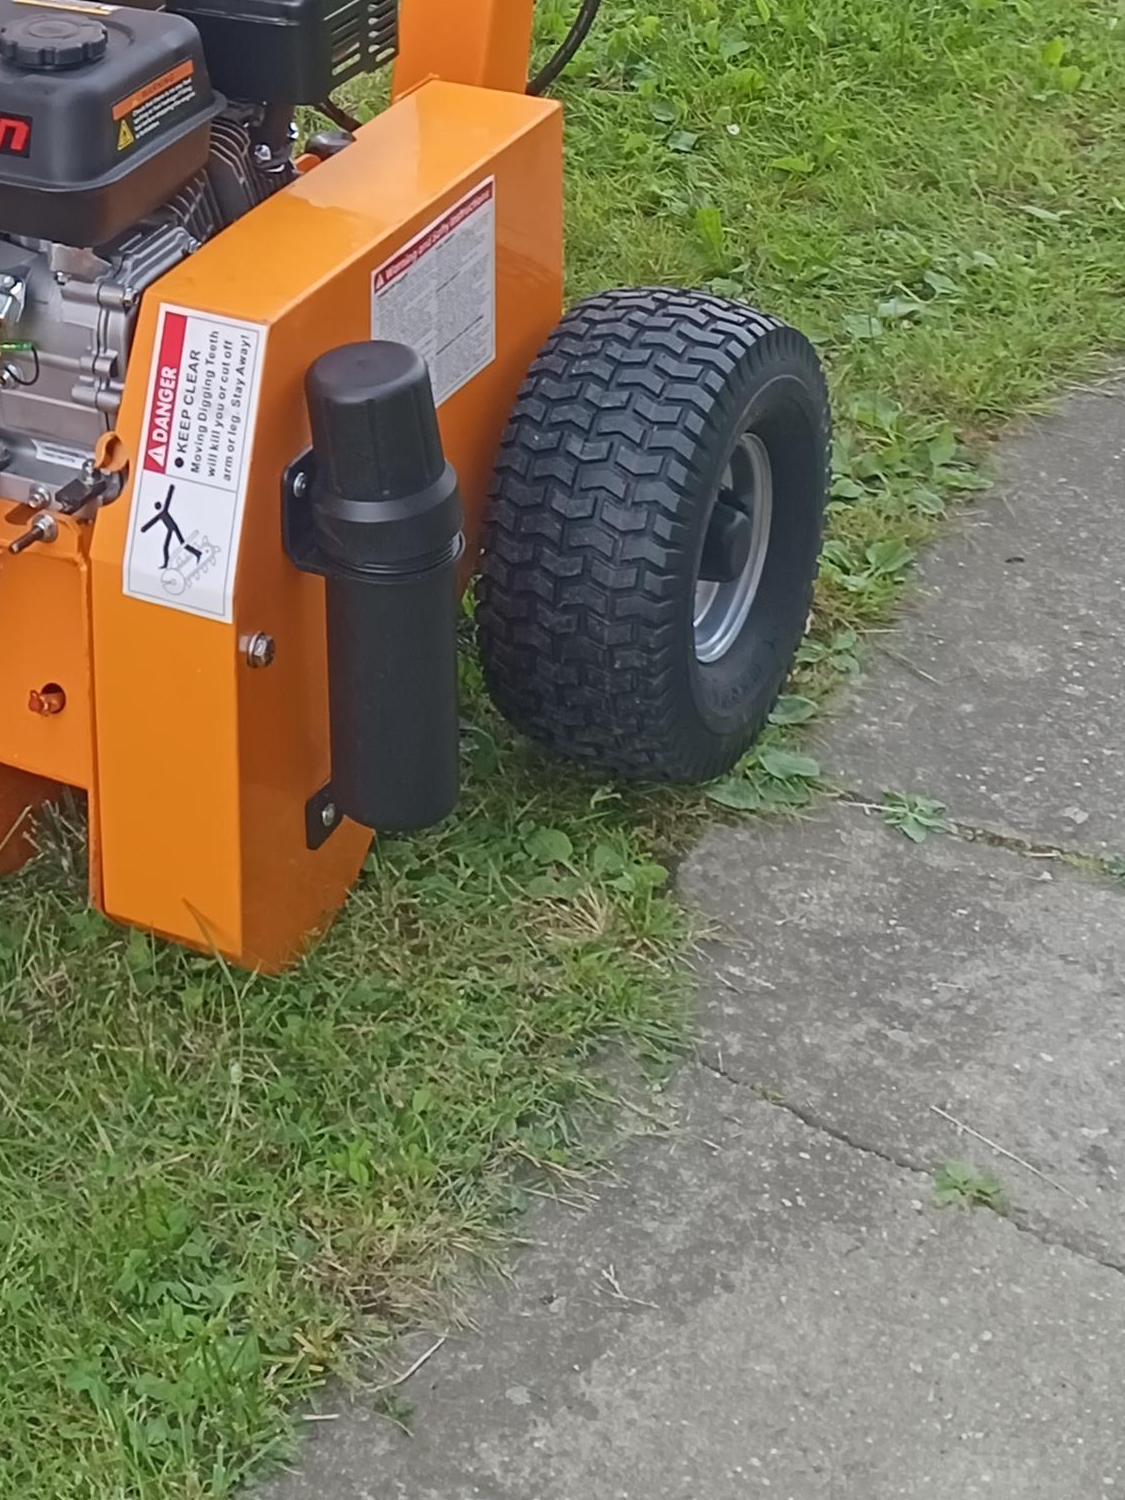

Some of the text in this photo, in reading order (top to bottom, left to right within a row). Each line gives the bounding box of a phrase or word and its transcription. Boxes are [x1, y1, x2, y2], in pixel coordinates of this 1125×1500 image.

[236, 334, 251, 376] Away!
[152, 365, 177, 443] DANGER
[176, 349, 201, 454] KEEP CLEAR
[190, 330, 220, 474] Moving Digging Teeth
[208, 340, 234, 477] will kill you or cut off
[231, 377, 246, 408] Stay
[224, 456, 233, 481] arm
[228, 438, 235, 452] or
